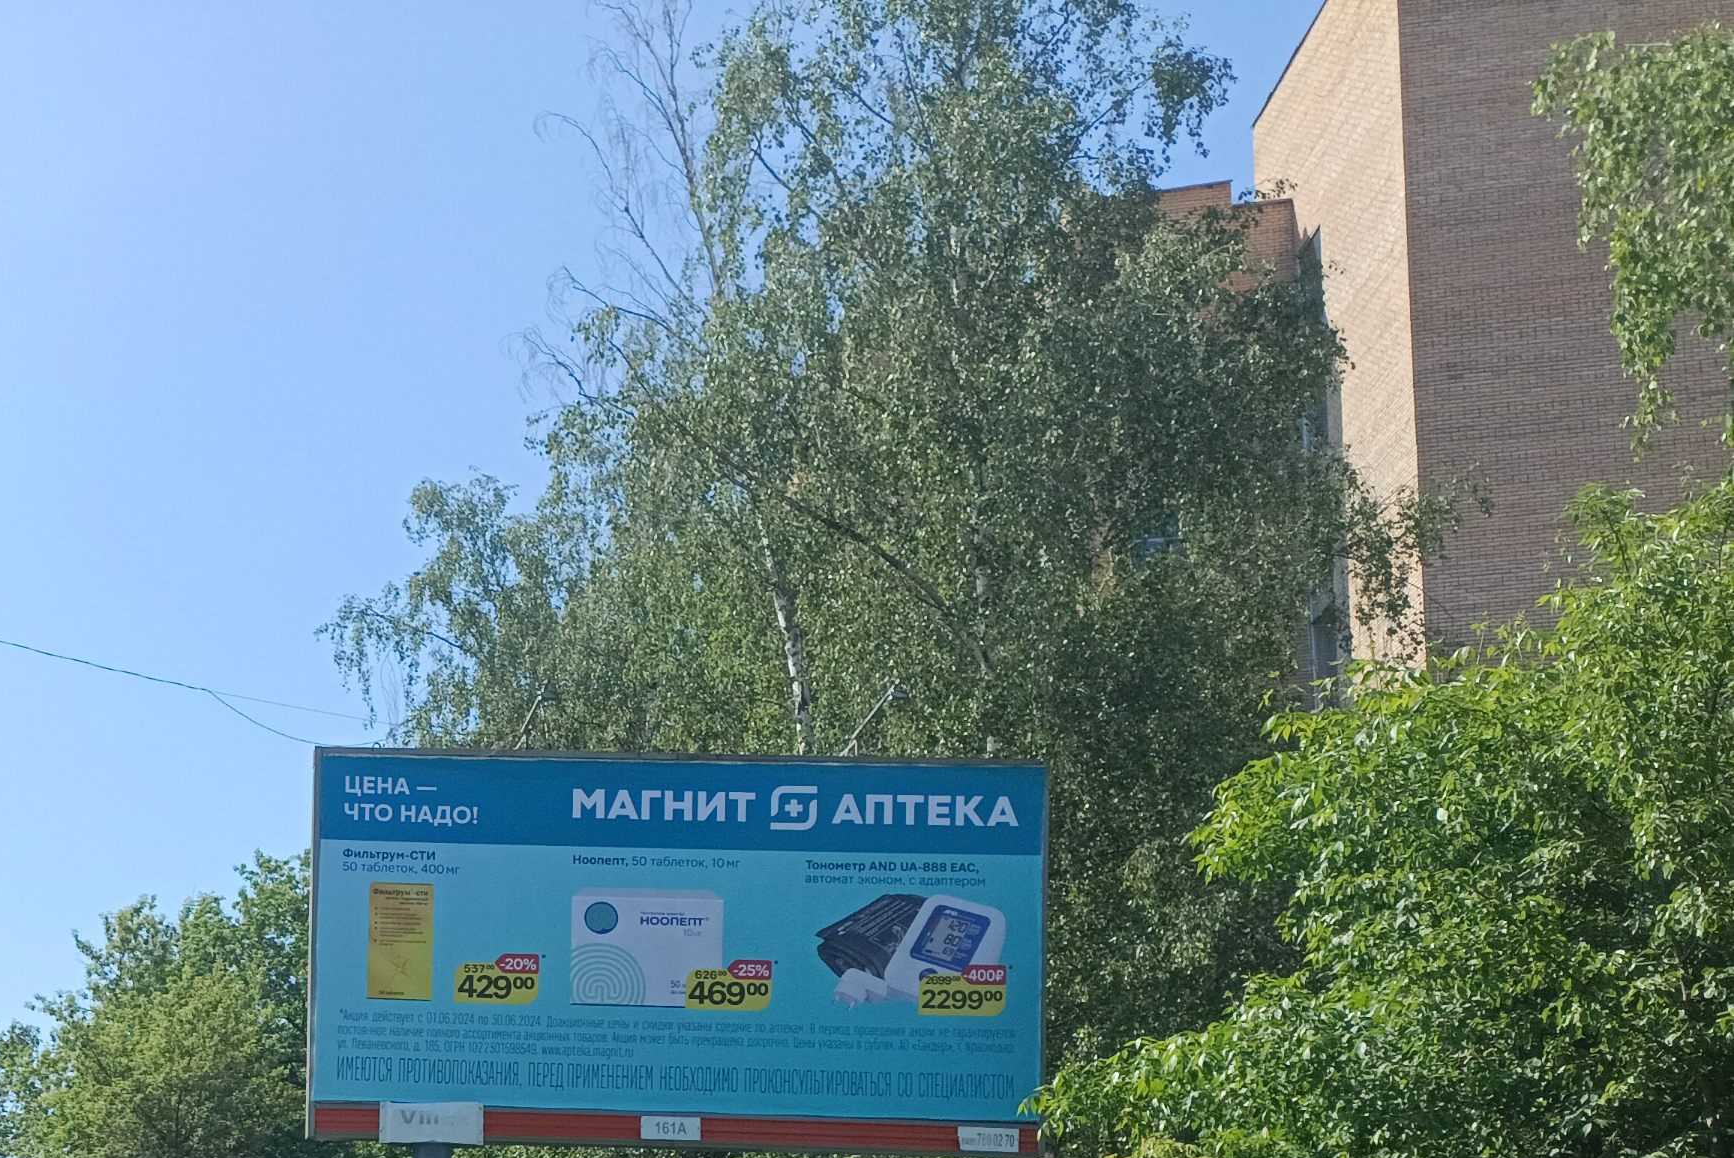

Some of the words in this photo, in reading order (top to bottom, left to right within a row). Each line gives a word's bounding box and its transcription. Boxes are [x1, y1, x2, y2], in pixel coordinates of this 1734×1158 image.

[344, 775, 410, 796] ЦЕНА
[344, 802, 393, 823] ЧТО
[400, 804, 479, 827] НАДО!
[571, 788, 756, 823] МАГНИТ
[832, 793, 1019, 827] АПТЕКА
[342, 847, 436, 861] Фильтрум-СТИ
[572, 854, 629, 868] Ноопепт,
[631, 856, 647, 867] 50
[651, 856, 708, 869] таблеток,
[342, 861, 357, 872] 50
[806, 859, 866, 874] Тонометр
[869, 861, 897, 872] AND
[900, 861, 947, 873] UA-888
[805, 874, 855, 886] автомат
[919, 876, 986, 890] адаптером
[337, 1055, 392, 1083] ИМЕЮТСЯ
[528, 1061, 564, 1090] ПЕРЕД
[567, 1063, 654, 1091] ПРИМЕНЕНИЕМ
[659, 1064, 739, 1096] НЕОБХОДИМО
[744, 1066, 892, 1097] ПРОКОНСУЛЬТИРОВАТЬСЯ
[897, 1071, 914, 1098] СО
[917, 1072, 1015, 1100] СПЕЦИАЛИСТОМ
